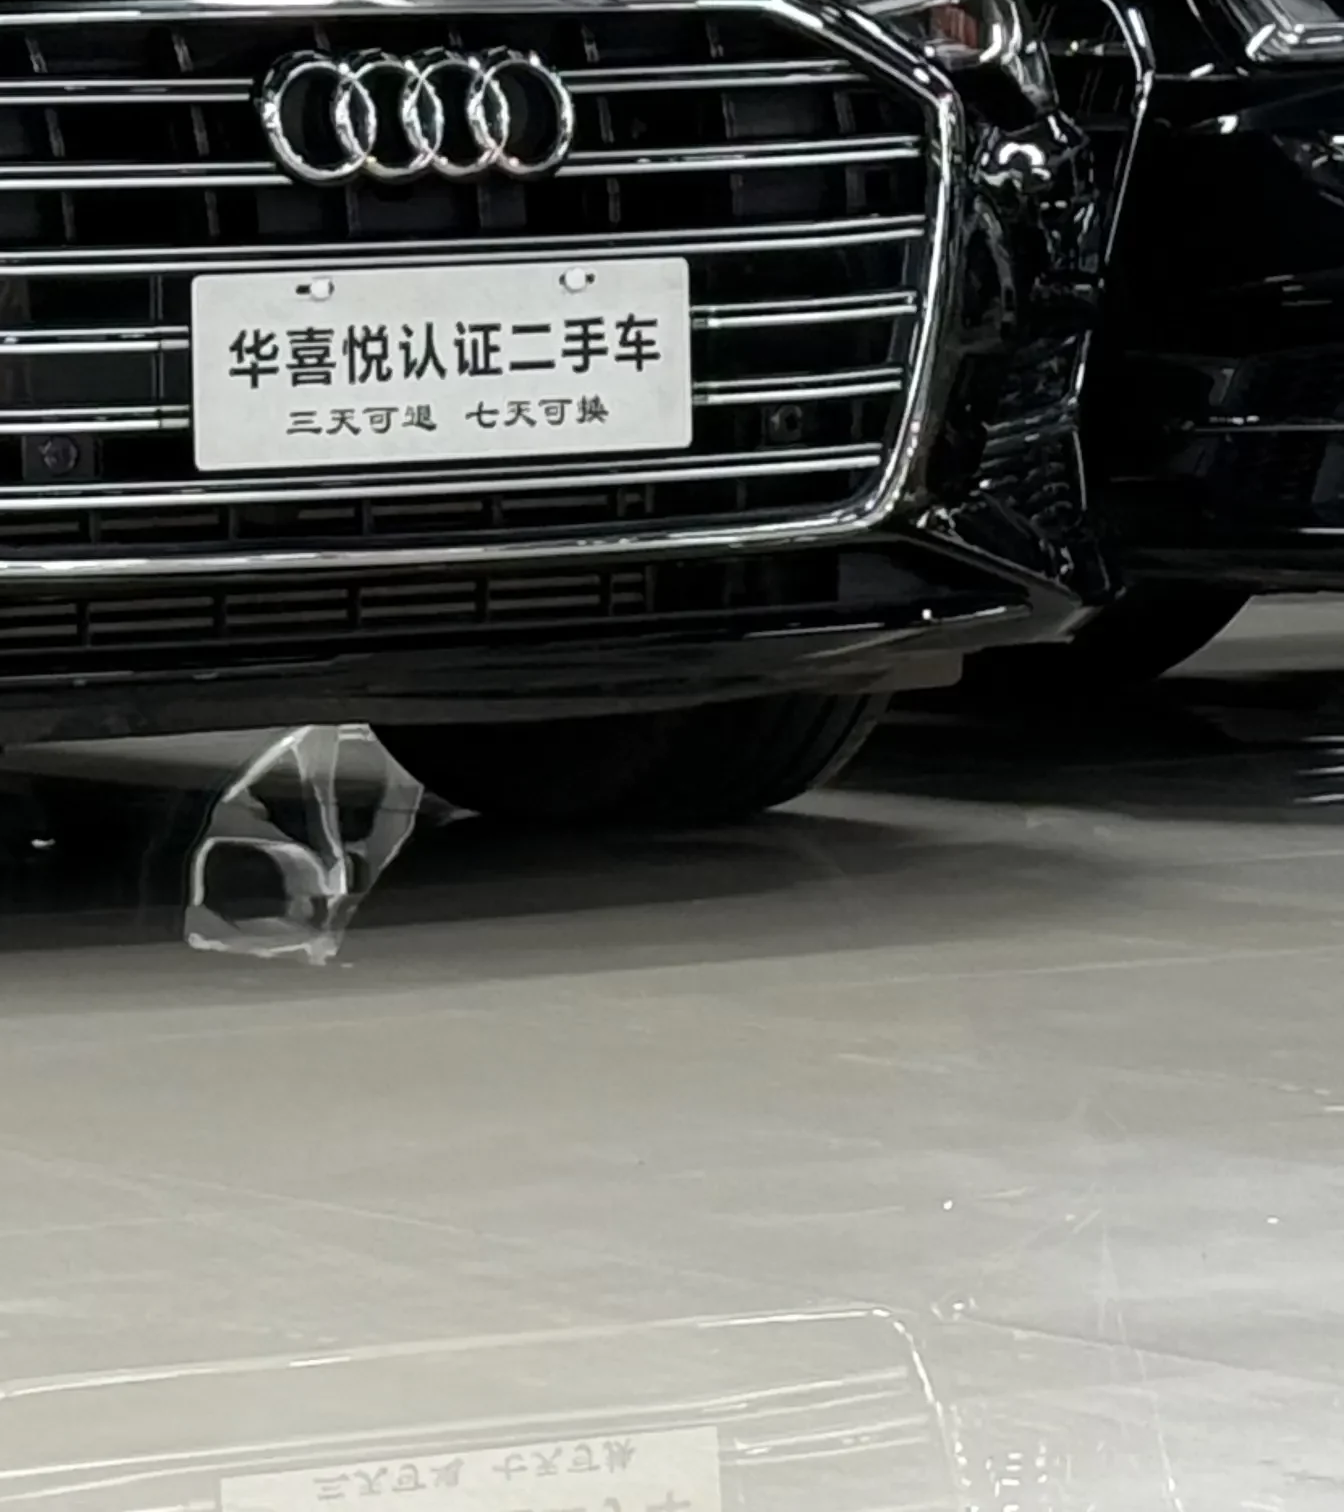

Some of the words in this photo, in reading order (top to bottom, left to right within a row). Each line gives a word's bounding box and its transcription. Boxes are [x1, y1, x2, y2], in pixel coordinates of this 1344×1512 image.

[228, 314, 661, 389] 华喜悦认证二手车
[285, 403, 439, 436] 三天可退
[464, 395, 610, 429] 七天可换
